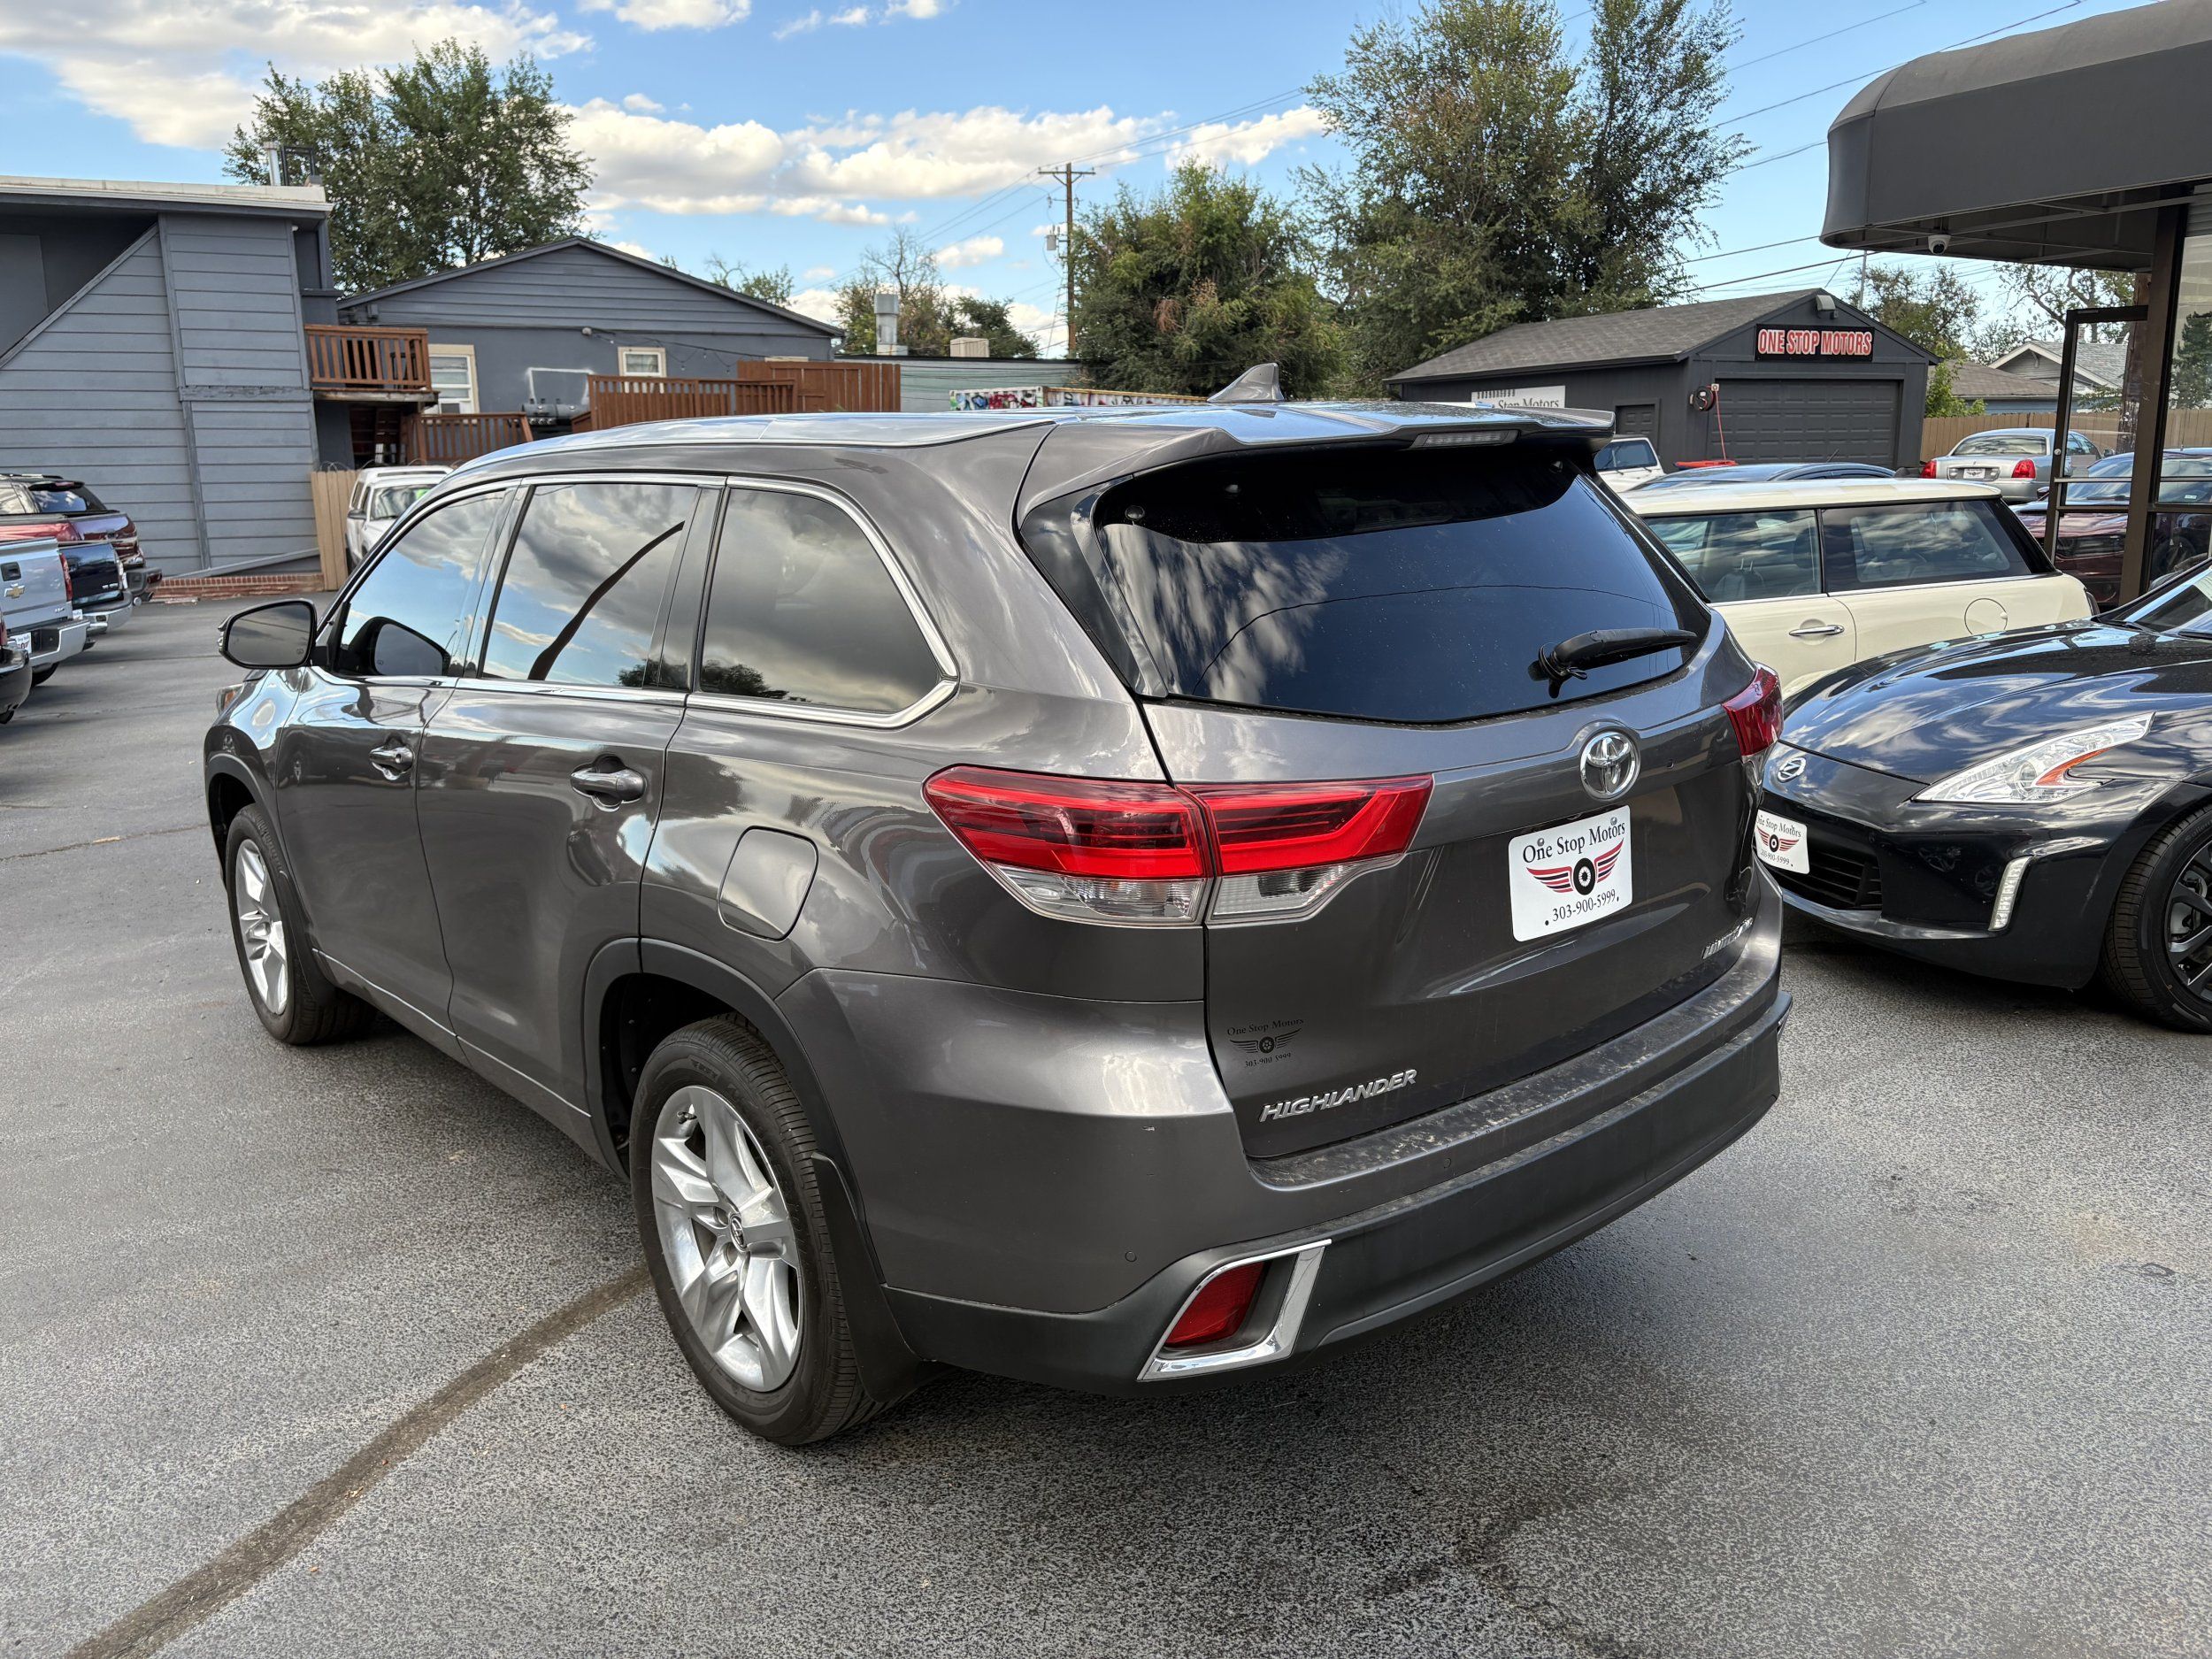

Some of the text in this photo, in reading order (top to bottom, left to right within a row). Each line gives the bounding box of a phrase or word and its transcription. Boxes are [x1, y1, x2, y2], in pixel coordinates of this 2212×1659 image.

[1757, 329, 1872, 356] ONE STOP MOTORS
[1523, 822, 1626, 864] One Stop Motors
[1778, 823, 1801, 838] Motors
[1552, 888, 1616, 922] 303-900-5999
[1226, 1018, 1304, 1036] One Stop Motors
[1258, 1069, 1417, 1123] HIGHLANDER
